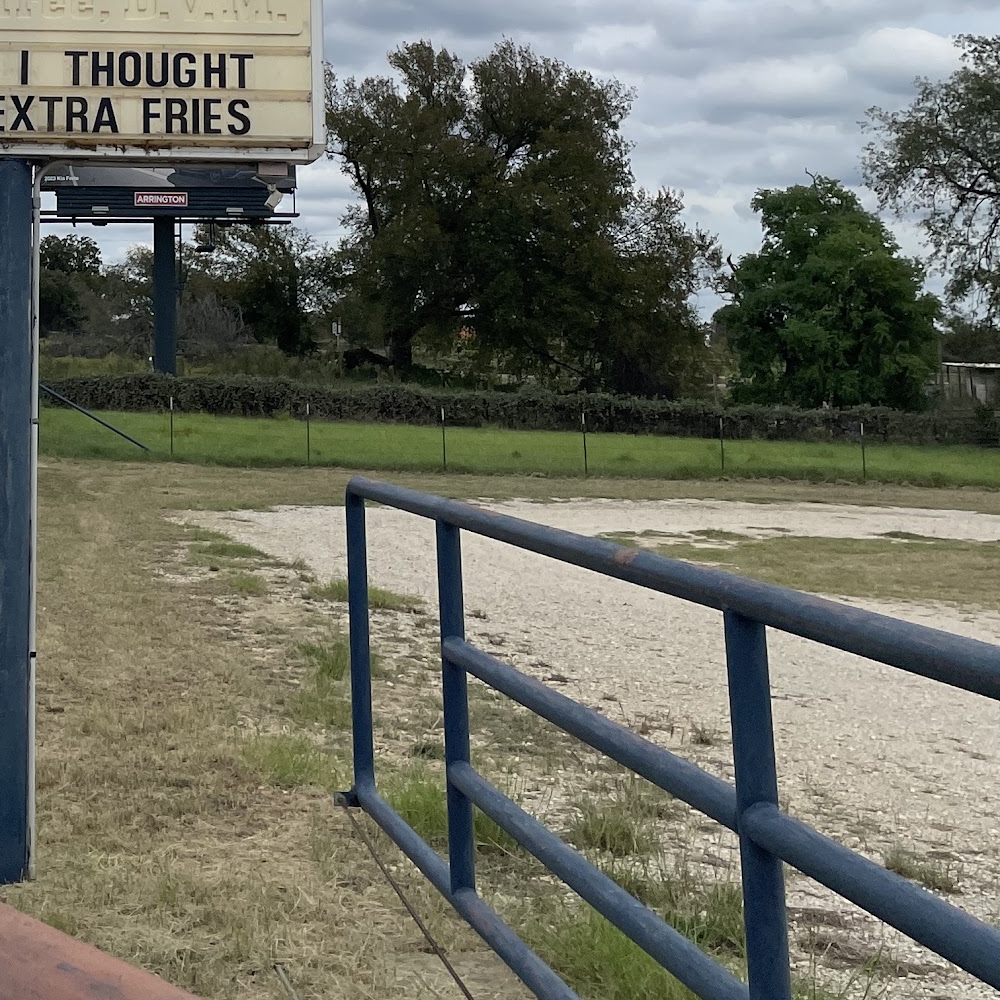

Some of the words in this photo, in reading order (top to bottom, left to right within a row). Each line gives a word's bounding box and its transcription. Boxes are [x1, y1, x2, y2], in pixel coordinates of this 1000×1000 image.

[20, 50, 29, 86] I
[64, 50, 254, 89] THOUGHT
[142, 97, 251, 136] FRIES
[136, 194, 185, 204] ARRINGTON
